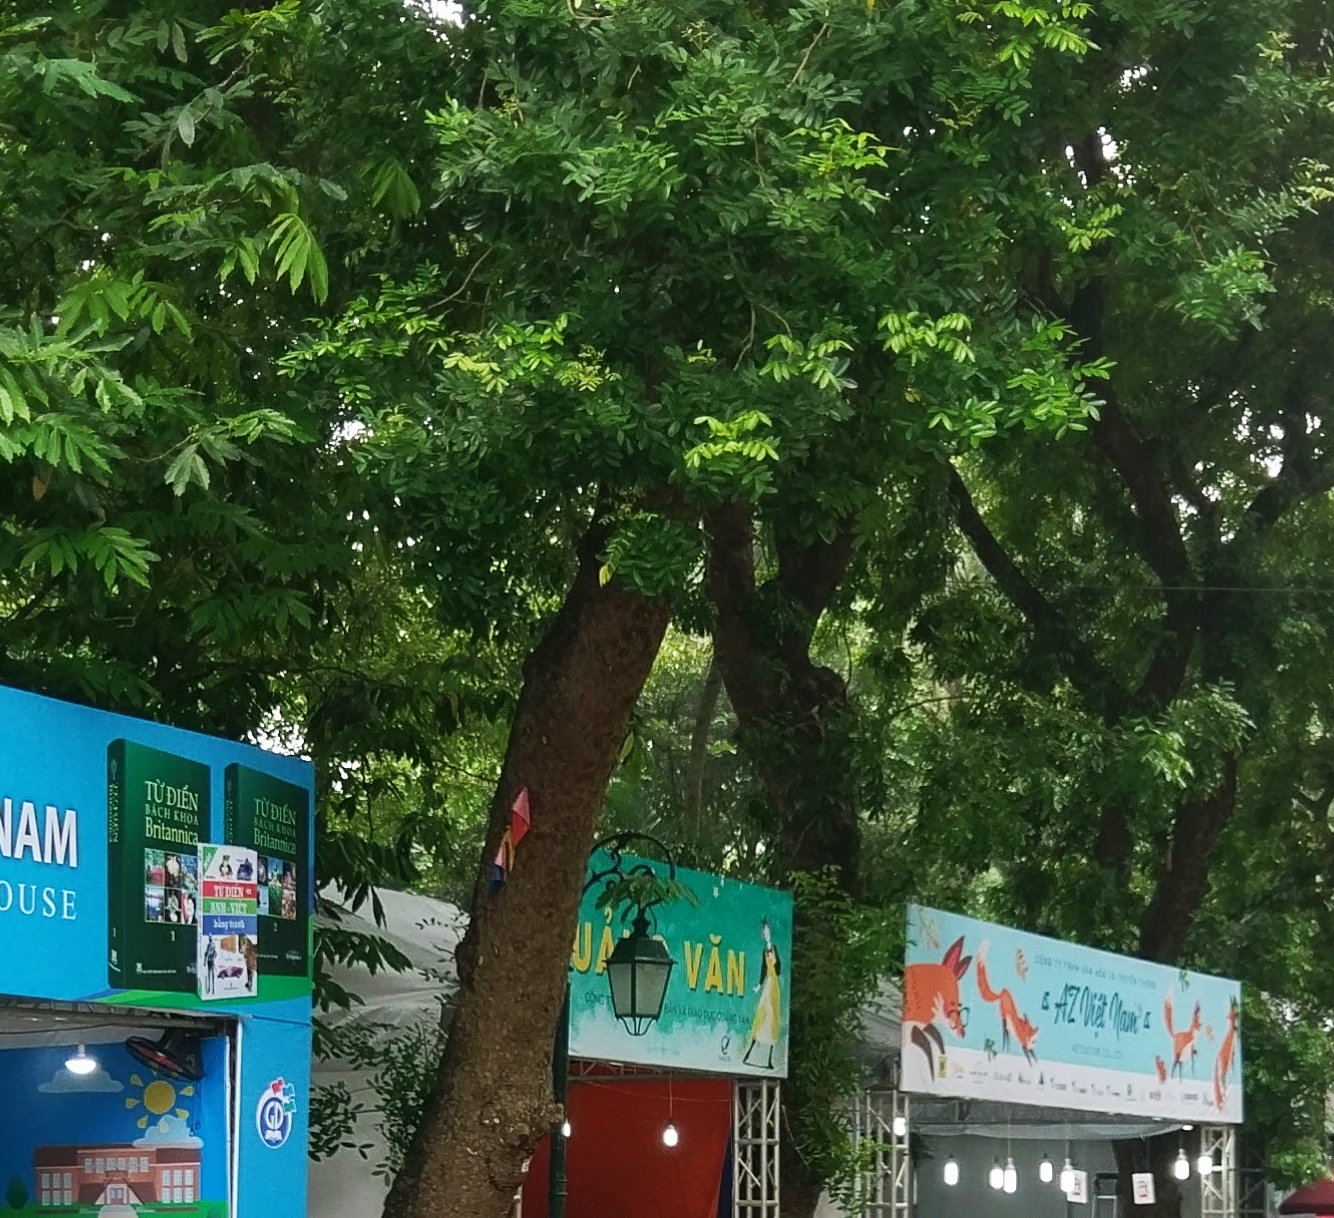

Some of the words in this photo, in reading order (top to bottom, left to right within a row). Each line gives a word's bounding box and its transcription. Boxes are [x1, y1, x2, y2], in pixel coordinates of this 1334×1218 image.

[145, 779, 165, 803] TỪ
[145, 816, 199, 846] Britannica
[174, 810, 199, 826] KHOA
[254, 827, 296, 855] Britannica
[684, 933, 745, 998] VĂN
